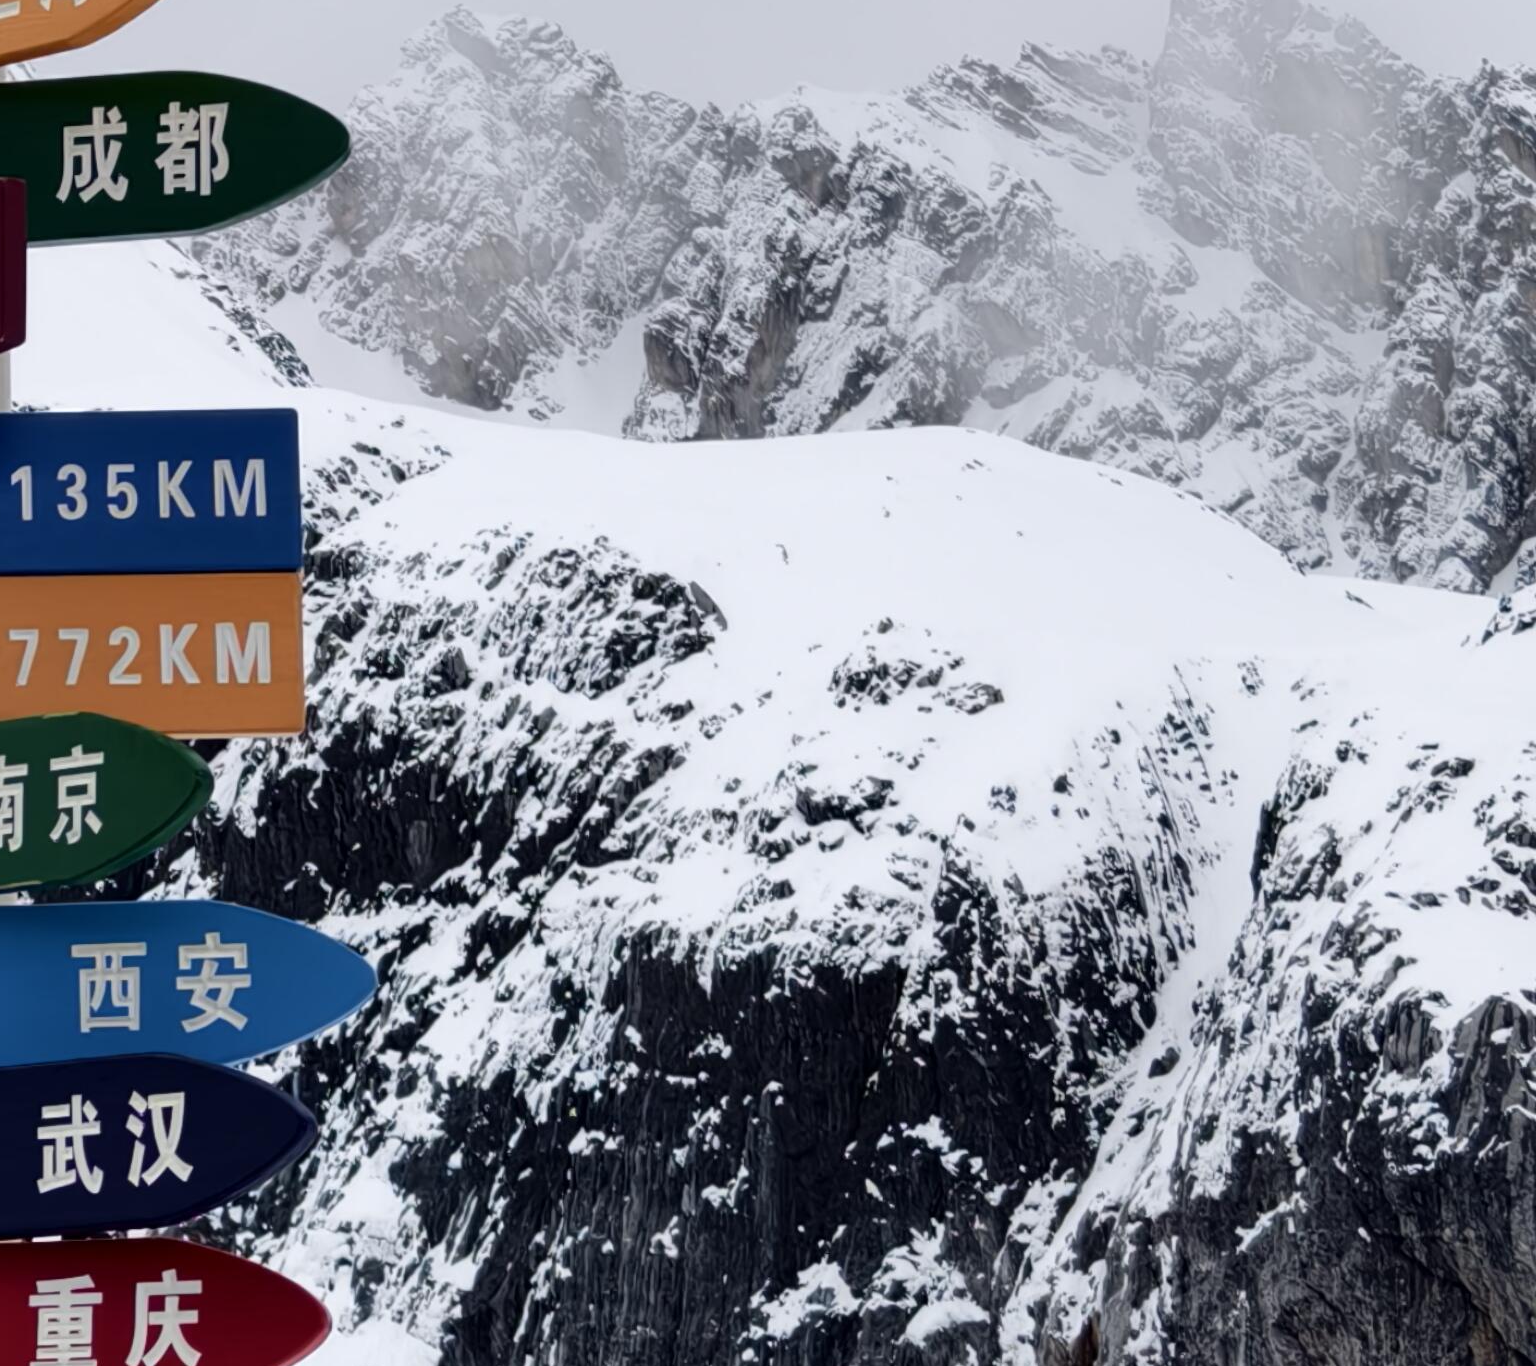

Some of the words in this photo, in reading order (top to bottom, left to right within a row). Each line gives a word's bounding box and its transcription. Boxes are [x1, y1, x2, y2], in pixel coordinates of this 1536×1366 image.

[56, 102, 229, 203] 成都
[71, 932, 251, 1032] 西安
[37, 1091, 193, 1193] 武汉
